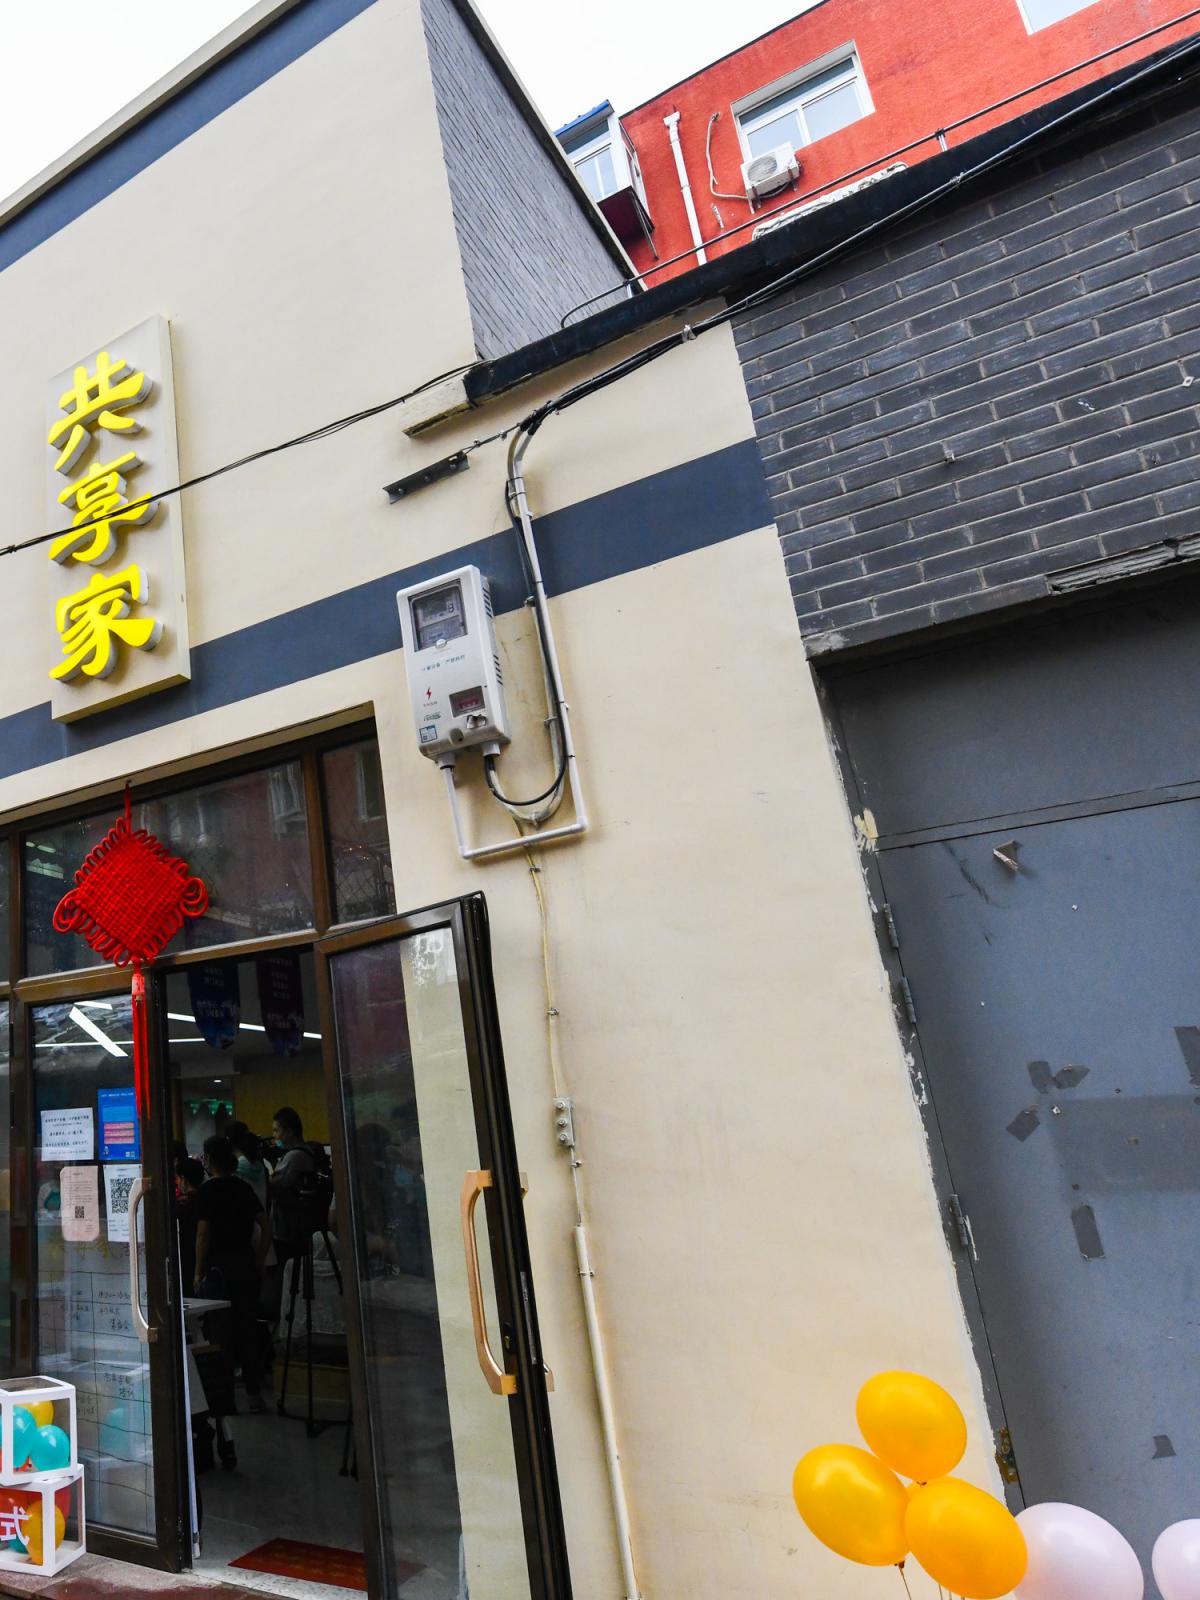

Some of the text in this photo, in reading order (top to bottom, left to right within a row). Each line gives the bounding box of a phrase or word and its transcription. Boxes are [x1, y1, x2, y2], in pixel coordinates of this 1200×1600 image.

[48, 351, 156, 678] 共享家
[0, 1506, 31, 1546] 式
